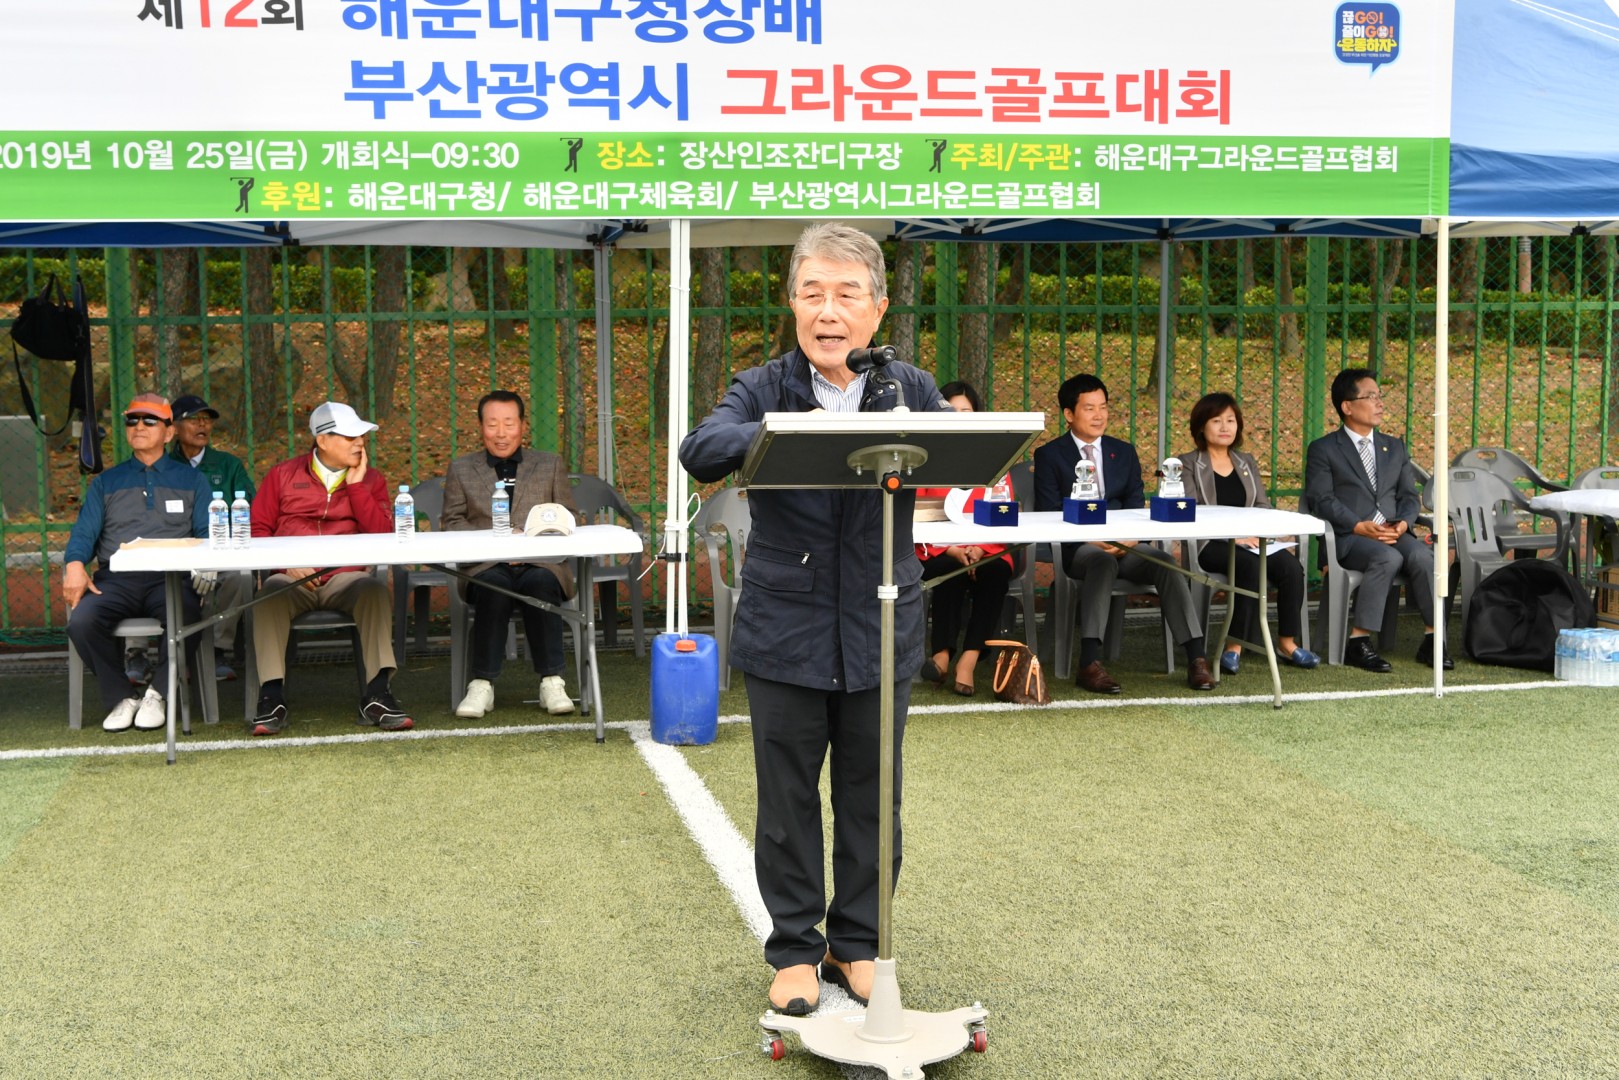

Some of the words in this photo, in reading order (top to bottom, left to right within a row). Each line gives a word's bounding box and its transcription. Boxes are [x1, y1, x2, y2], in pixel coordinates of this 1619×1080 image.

[343, 0, 821, 44] 해운대구청장배
[345, 61, 688, 120] 부산광역시
[721, 65, 1230, 124] 그라운드골프대회
[0, 141, 91, 169] 019년
[108, 140, 173, 170] 10월
[187, 140, 307, 171] 25일(금)
[598, 141, 664, 169] 장소:
[680, 141, 902, 170] 장산인조잔디구장
[951, 143, 1081, 171] 주최/주관:
[1095, 144, 1397, 172] 해운대구그라운드골프협회
[261, 182, 332, 211] 후원:
[348, 182, 511, 211] 해운대구청/
[524, 181, 738, 210] 해운대구체육회/
[750, 182, 1099, 209] 부산광역시그라운드골프협회
